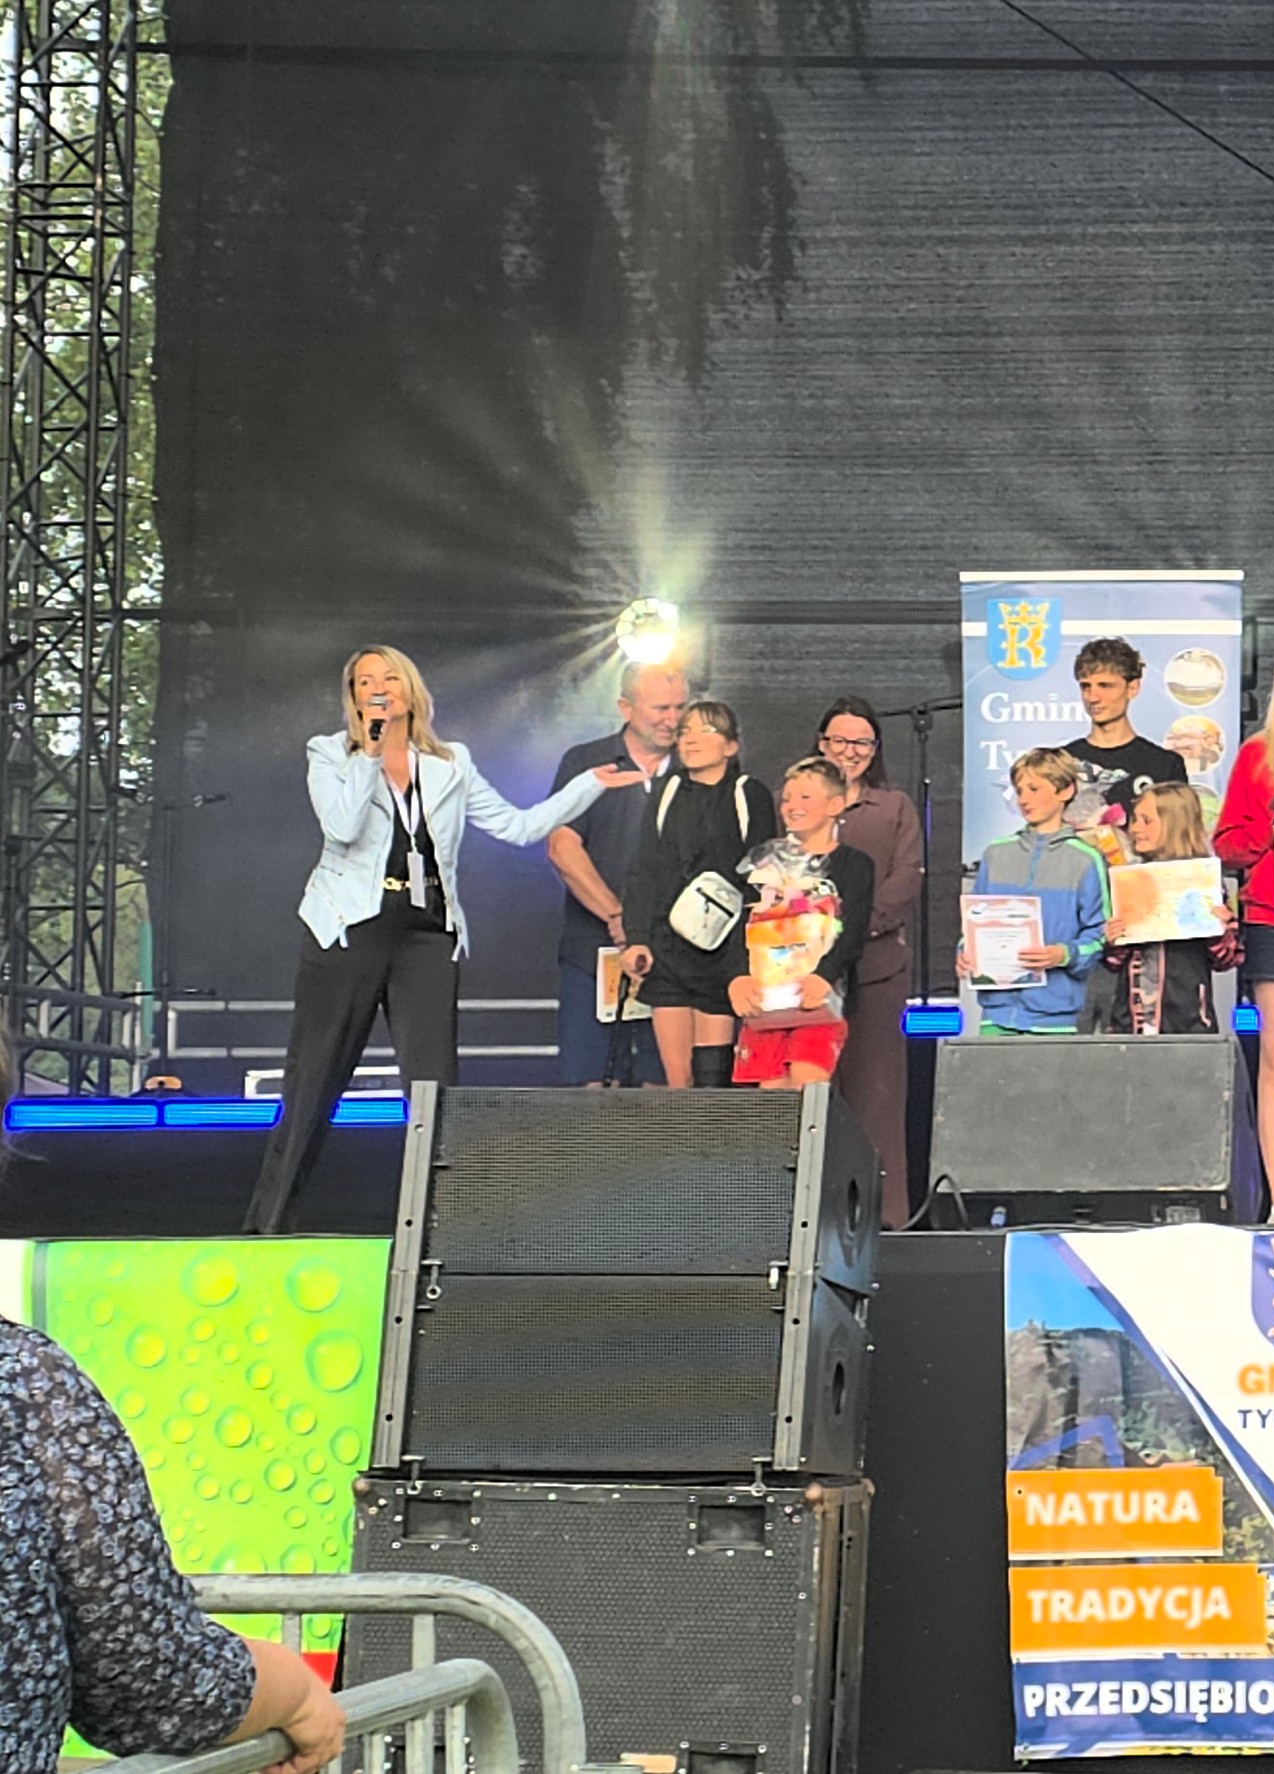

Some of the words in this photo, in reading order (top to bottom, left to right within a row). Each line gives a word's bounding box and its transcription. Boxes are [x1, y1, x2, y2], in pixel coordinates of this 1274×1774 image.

[980, 692, 1091, 723] Gmin
[1025, 1490, 1199, 1526] NATURA
[1027, 1586, 1231, 1629] TRADYCJA
